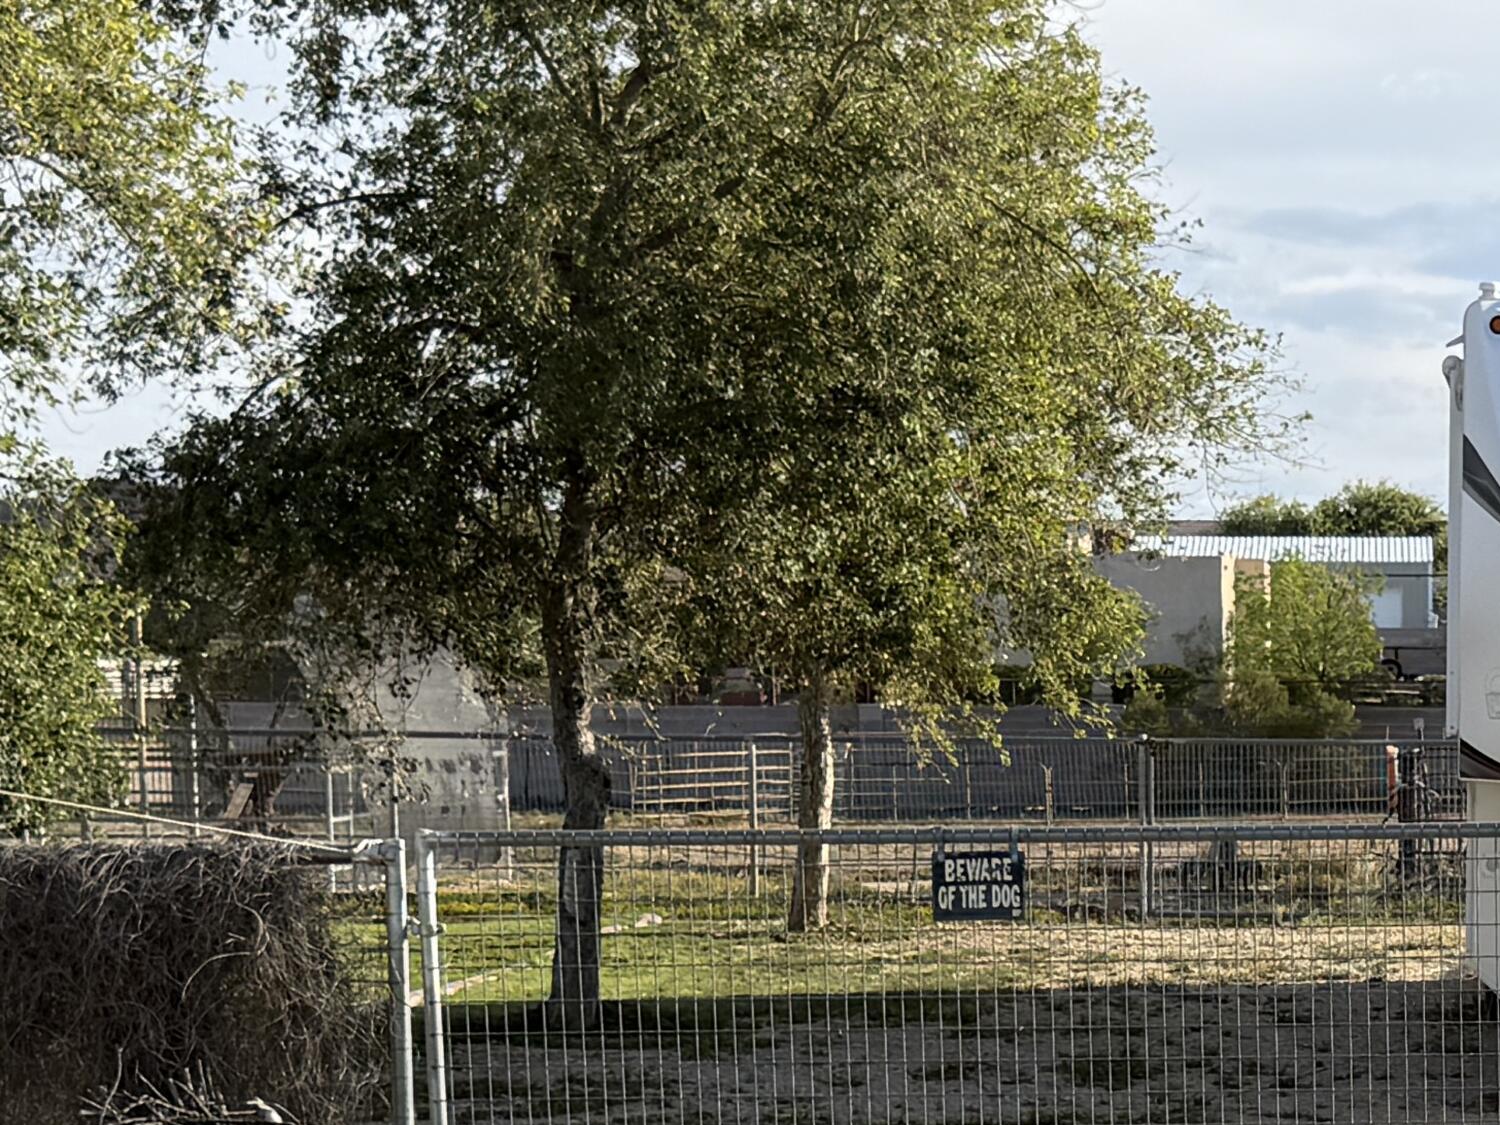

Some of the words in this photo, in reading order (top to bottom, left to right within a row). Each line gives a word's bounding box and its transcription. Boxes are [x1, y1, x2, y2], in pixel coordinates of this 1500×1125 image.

[945, 857, 1013, 882] BEWARE
[938, 886, 956, 911] OF
[959, 885, 987, 909] THE
[992, 884, 1021, 908] DOG
